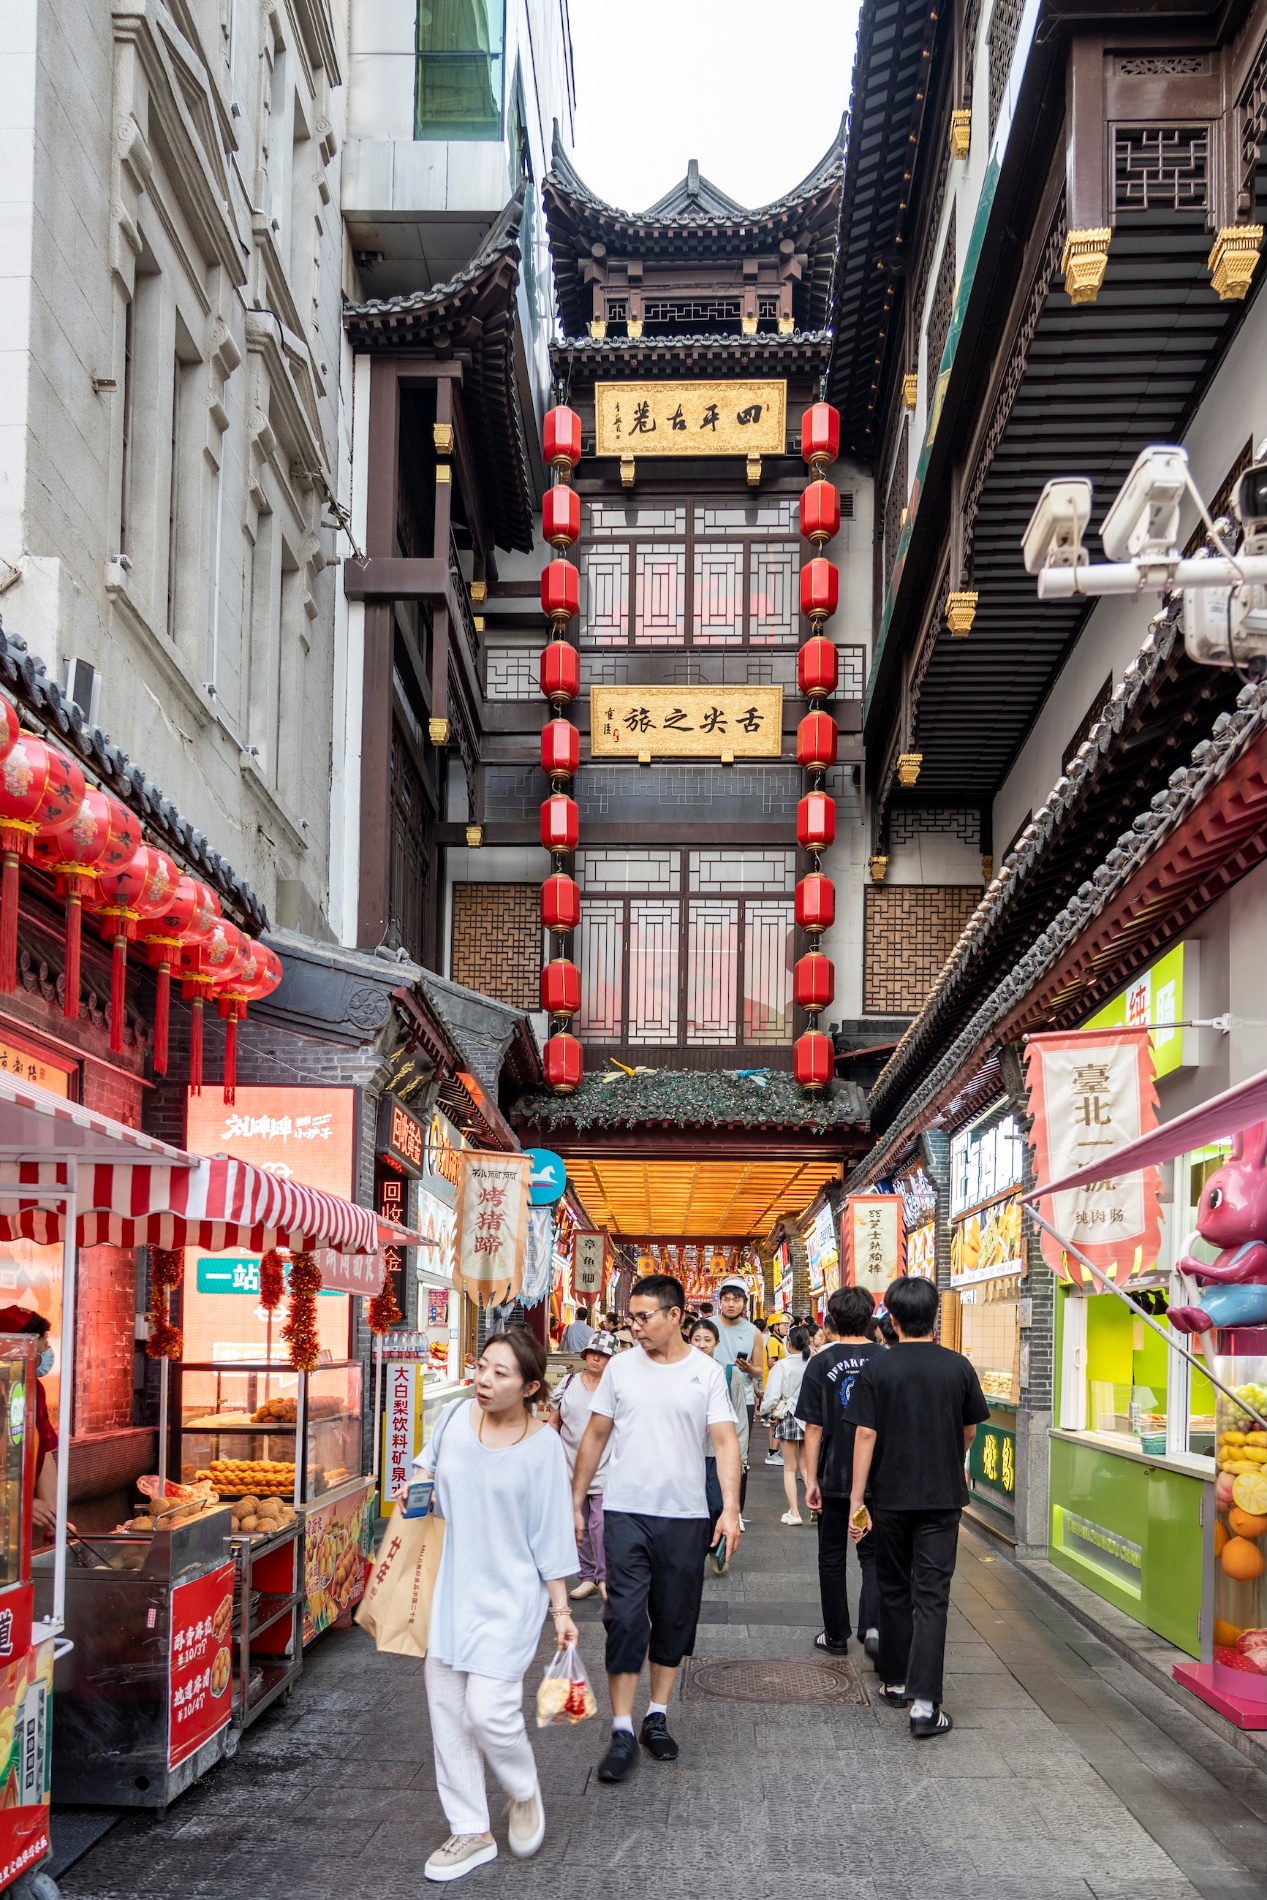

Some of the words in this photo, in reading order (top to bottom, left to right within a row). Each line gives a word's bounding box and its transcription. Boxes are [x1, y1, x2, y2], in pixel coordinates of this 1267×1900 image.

[623, 706, 765, 734] 舌尖之旅
[391, 1106, 425, 1167] 回收黄金
[381, 1181, 403, 1272] 回收金
[474, 1186, 508, 1256] 烤猪蹄
[1075, 1208, 1125, 1225] 纯肉肠
[827, 1358, 868, 1382] DEPART
